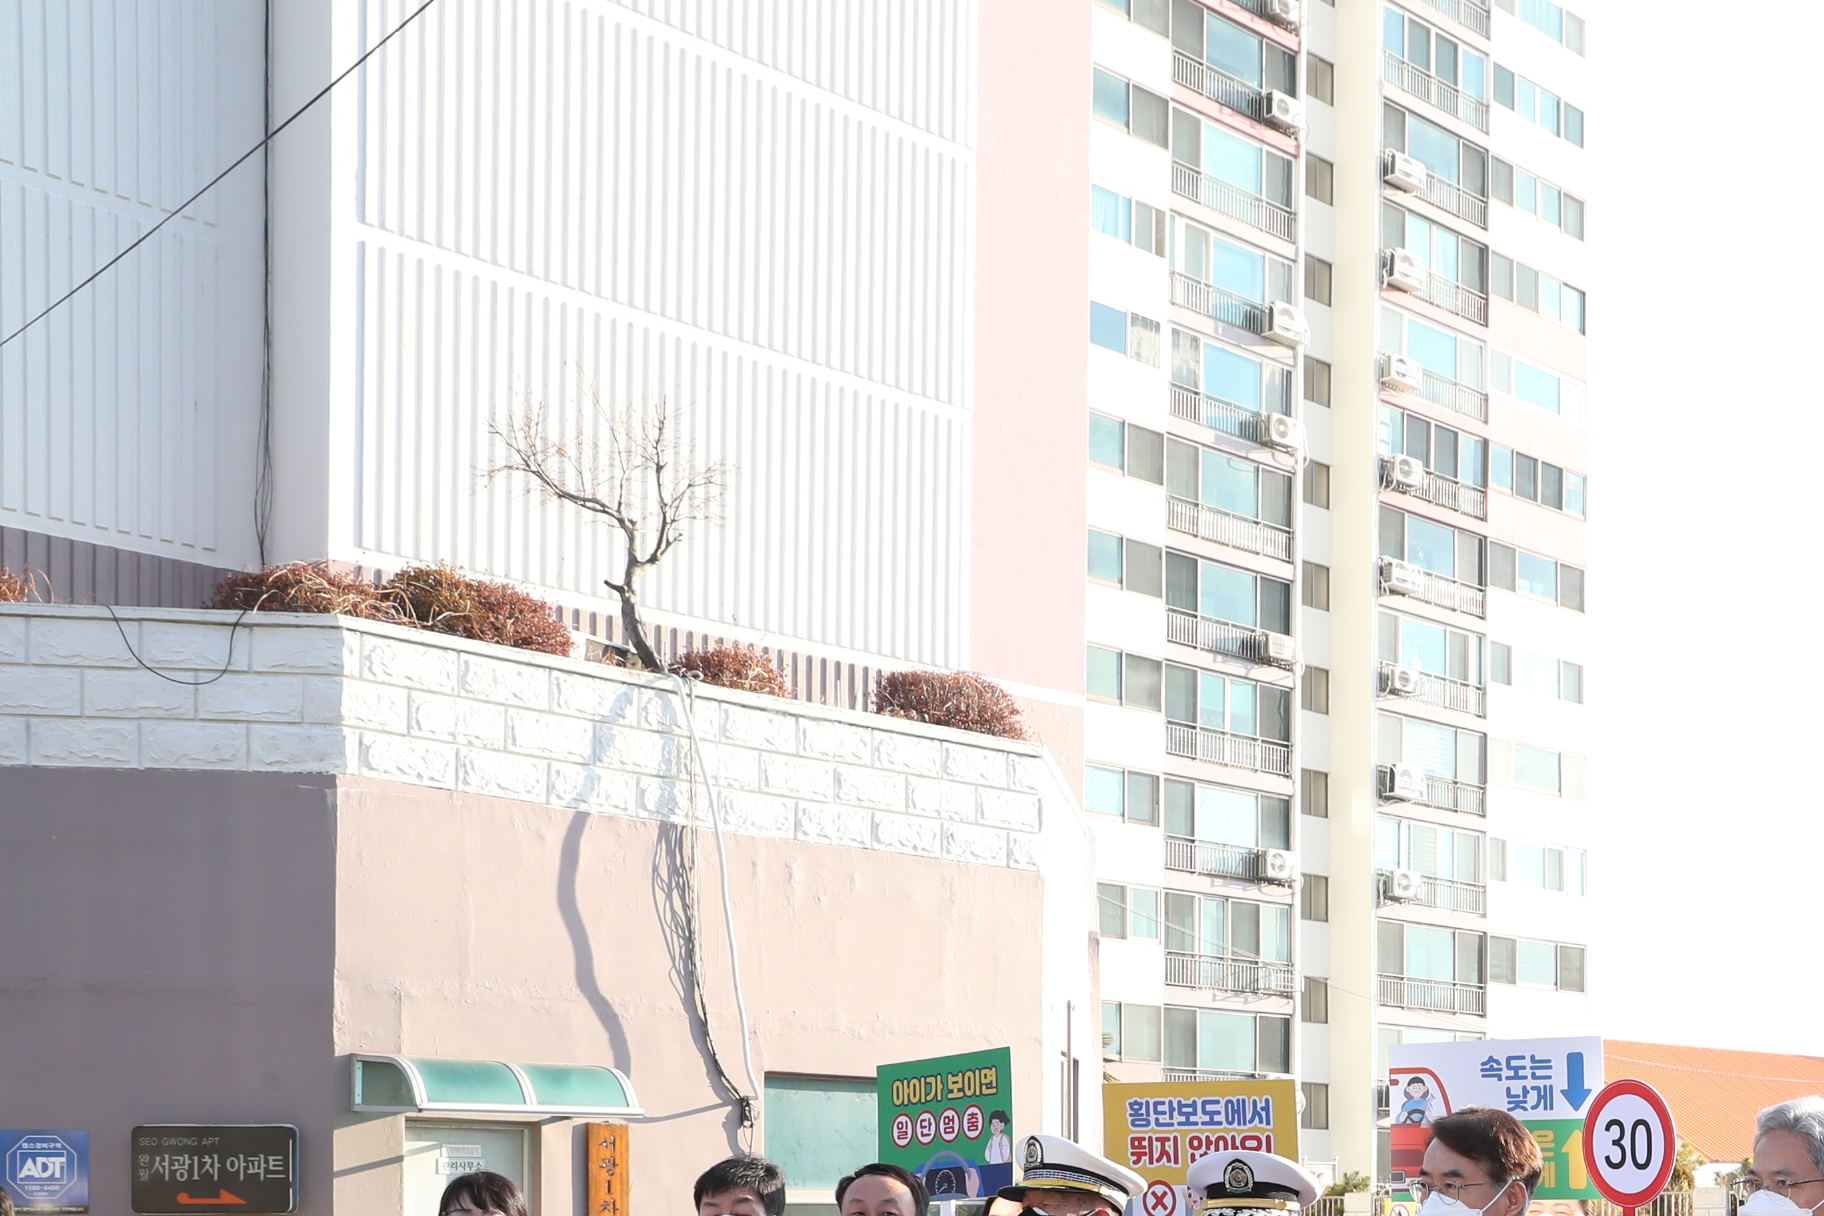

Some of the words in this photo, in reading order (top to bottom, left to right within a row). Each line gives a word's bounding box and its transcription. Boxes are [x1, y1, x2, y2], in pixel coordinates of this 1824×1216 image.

[1480, 1054, 1553, 1081] 속도는
[892, 1073, 944, 1107] 아이가
[946, 1065, 998, 1101] 보이면
[1506, 1084, 1554, 1112] 낮게
[1126, 1096, 1274, 1129] 횡단보도에서
[139, 1137, 158, 1146] SEO
[162, 1137, 198, 1146] GWONG
[202, 1137, 219, 1146] APT
[1129, 1134, 1181, 1166] 뛰지
[1604, 1118, 1652, 1171] 30
[19, 1157, 66, 1178] ADT
[151, 1153, 221, 1181] 서광1차
[226, 1153, 286, 1181] 아파트
